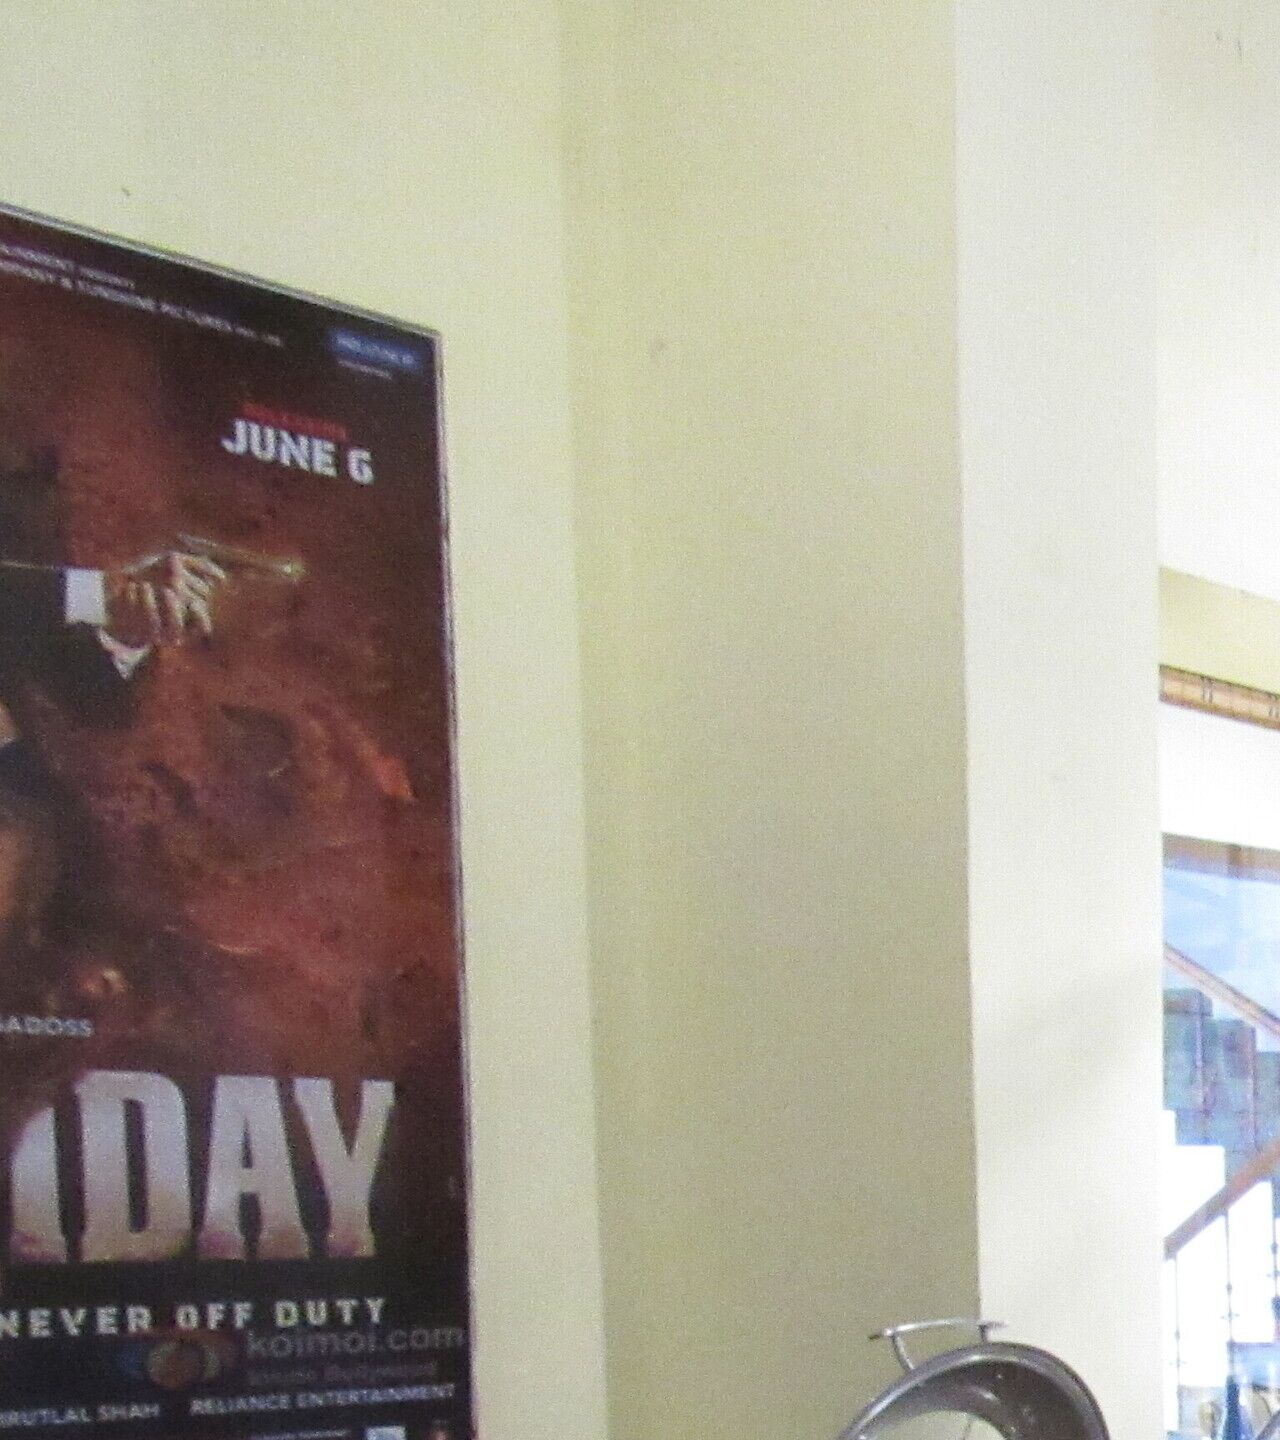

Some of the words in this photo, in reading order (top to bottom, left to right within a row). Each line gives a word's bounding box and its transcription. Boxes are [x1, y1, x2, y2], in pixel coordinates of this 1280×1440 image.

[221, 418, 338, 478] JUNE
[347, 447, 374, 485] 6
[0, 1015, 93, 1037] ADOSS
[0, 1304, 151, 1339] NEVER
[175, 1301, 253, 1331] OFF
[275, 1297, 385, 1329] DUTY
[98, 1403, 160, 1422] SHAH
[190, 1394, 290, 1416] RELIANCE
[297, 1383, 455, 1408] ENTERTAINMENT
